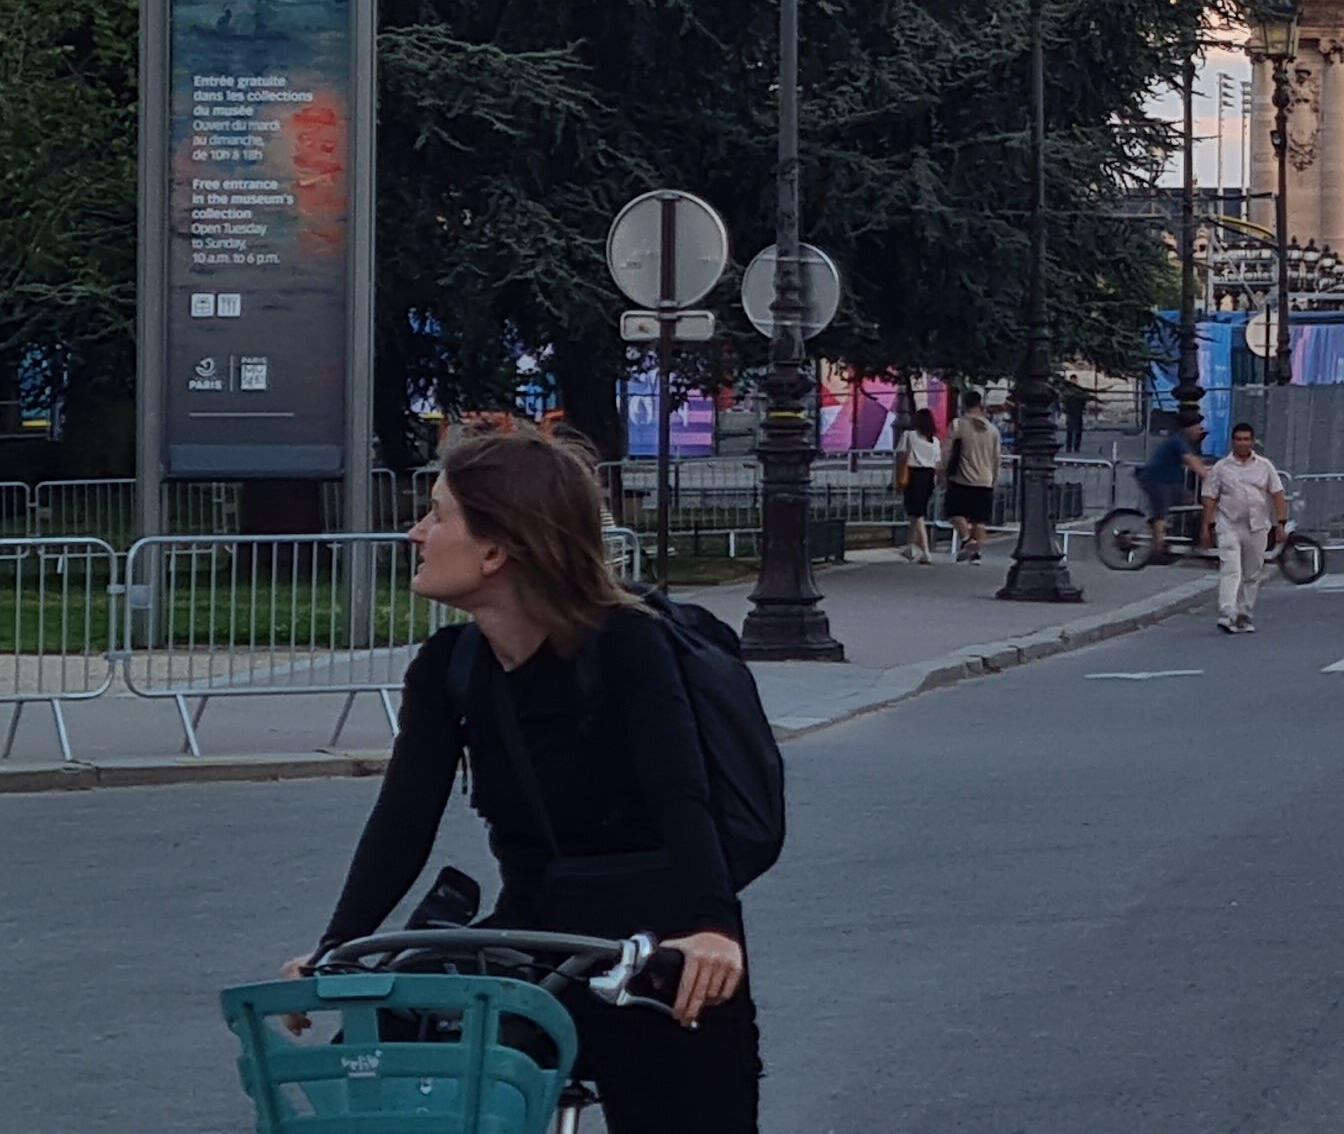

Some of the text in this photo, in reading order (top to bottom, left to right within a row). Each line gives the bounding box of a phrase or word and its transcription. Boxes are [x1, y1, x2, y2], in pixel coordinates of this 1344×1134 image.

[193, 75, 286, 89] Entrée gratuite
[193, 90, 313, 102] dans les collections
[193, 105, 254, 116] du musée
[192, 119, 281, 131] Ouvert du mardi
[192, 135, 208, 146] au
[192, 149, 208, 161] de
[192, 178, 278, 190] Free entrance
[192, 193, 294, 205] in the museum's
[191, 207, 252, 219] collection
[191, 222, 268, 237] Open Tuesday
[191, 238, 204, 248] to
[192, 252, 206, 264] 10
[232, 252, 246, 264] to
[246, 253, 256, 264] 6
[188, 379, 222, 390] PARIS
